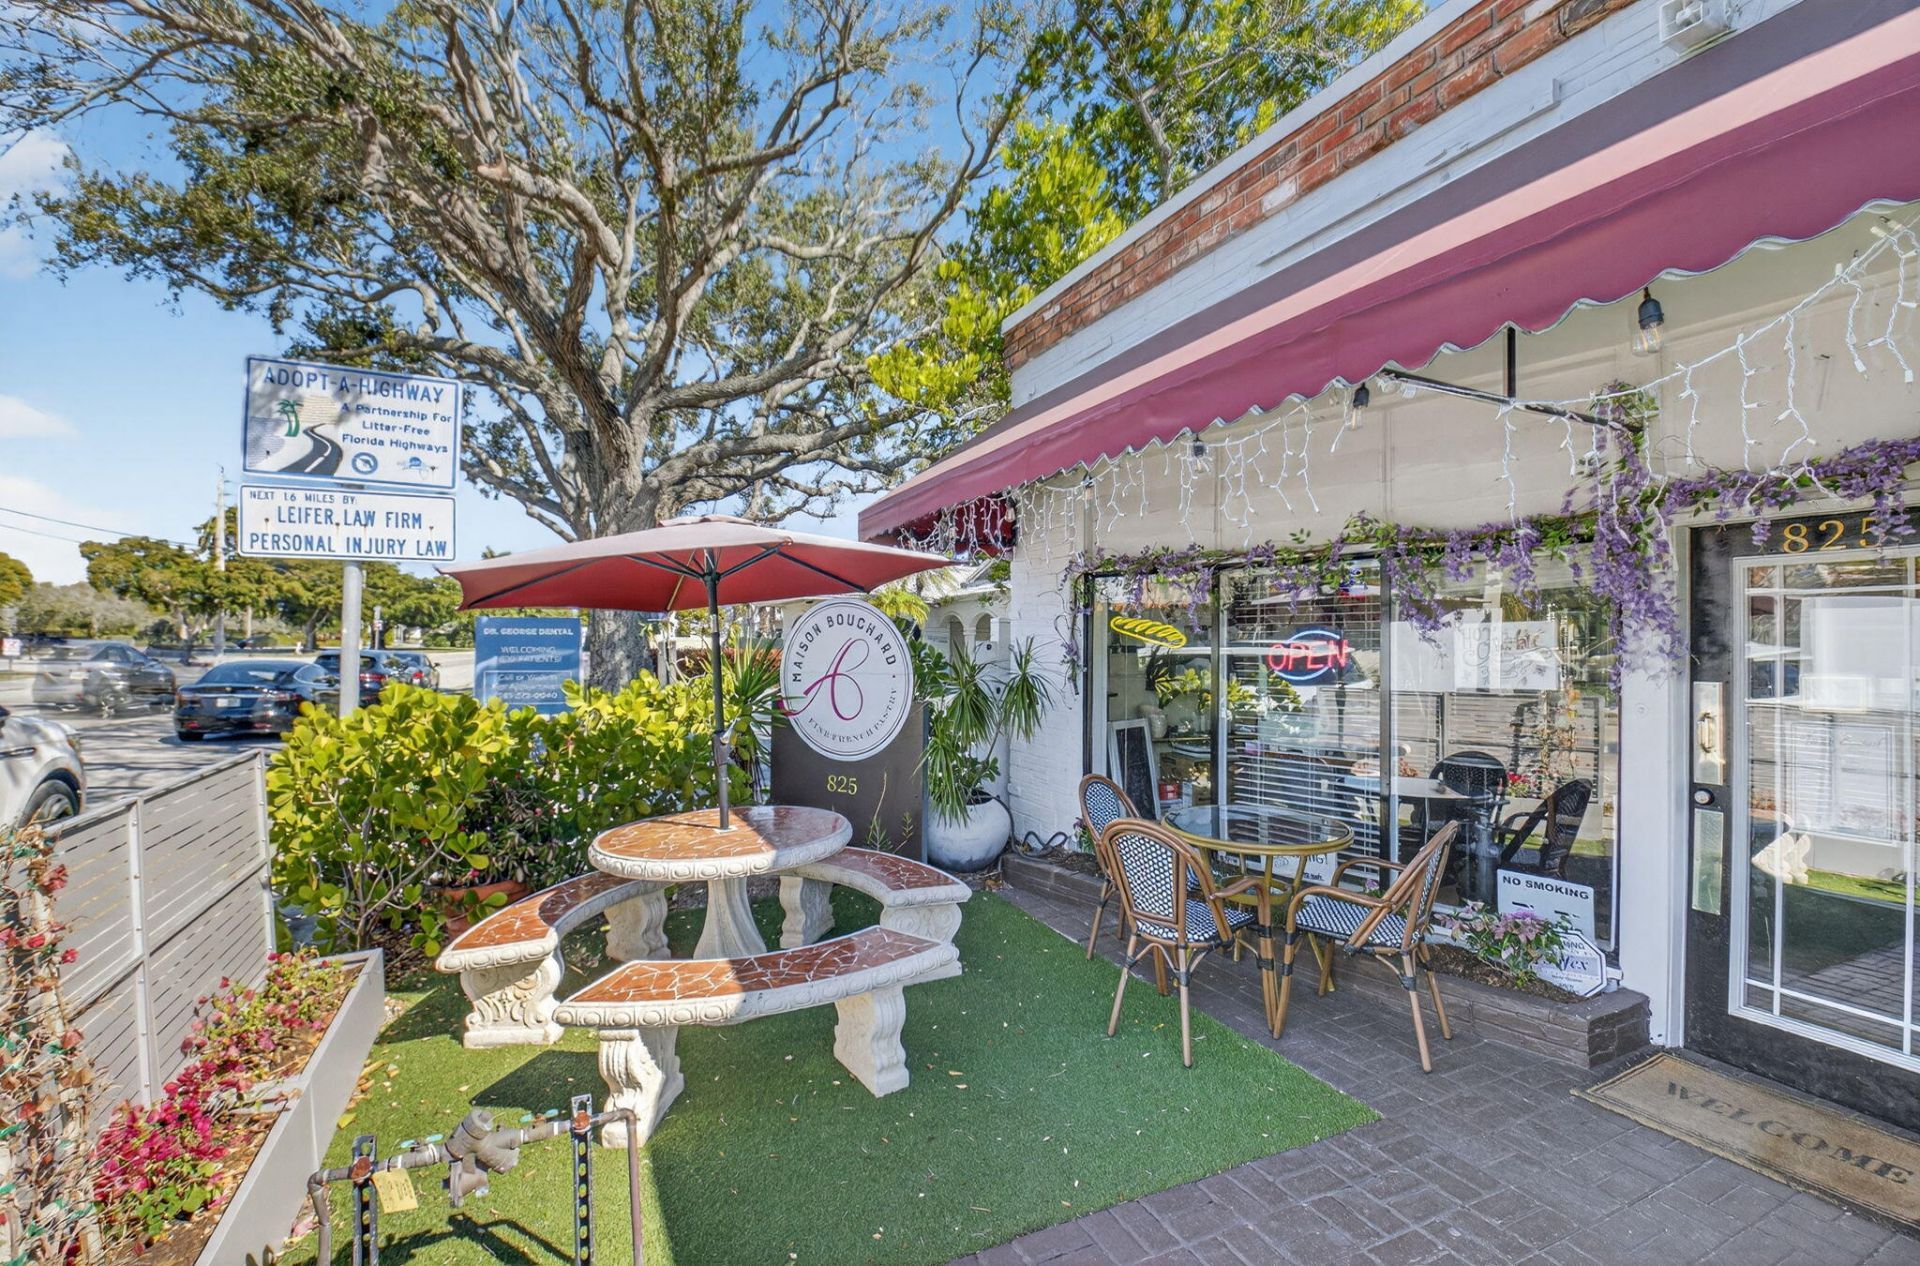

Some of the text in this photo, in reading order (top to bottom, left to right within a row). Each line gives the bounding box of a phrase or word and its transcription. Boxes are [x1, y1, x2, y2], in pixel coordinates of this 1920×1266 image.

[263, 366, 444, 402] ADOPT-A-HIGHWAY
[356, 404, 428, 421] Partnership
[432, 413, 452, 423] For
[362, 420, 430, 436] Litter-Free
[342, 434, 448, 454] Florida Highways
[250, 490, 275, 500] NEXT
[304, 493, 335, 504] MILES
[277, 505, 422, 529] LEIFER LAW FIRM
[249, 532, 447, 557] PERSONAL INJURY LAW
[500, 627, 537, 636] GEORGE
[538, 627, 574, 636] DENTAL
[793, 613, 897, 682] MAISON BOUCHARD
[1267, 638, 1350, 672] OPEN
[826, 774, 858, 795] 825
[1502, 875, 1590, 901] NO SMOKING
[1667, 1081, 1914, 1185] WELCOME
